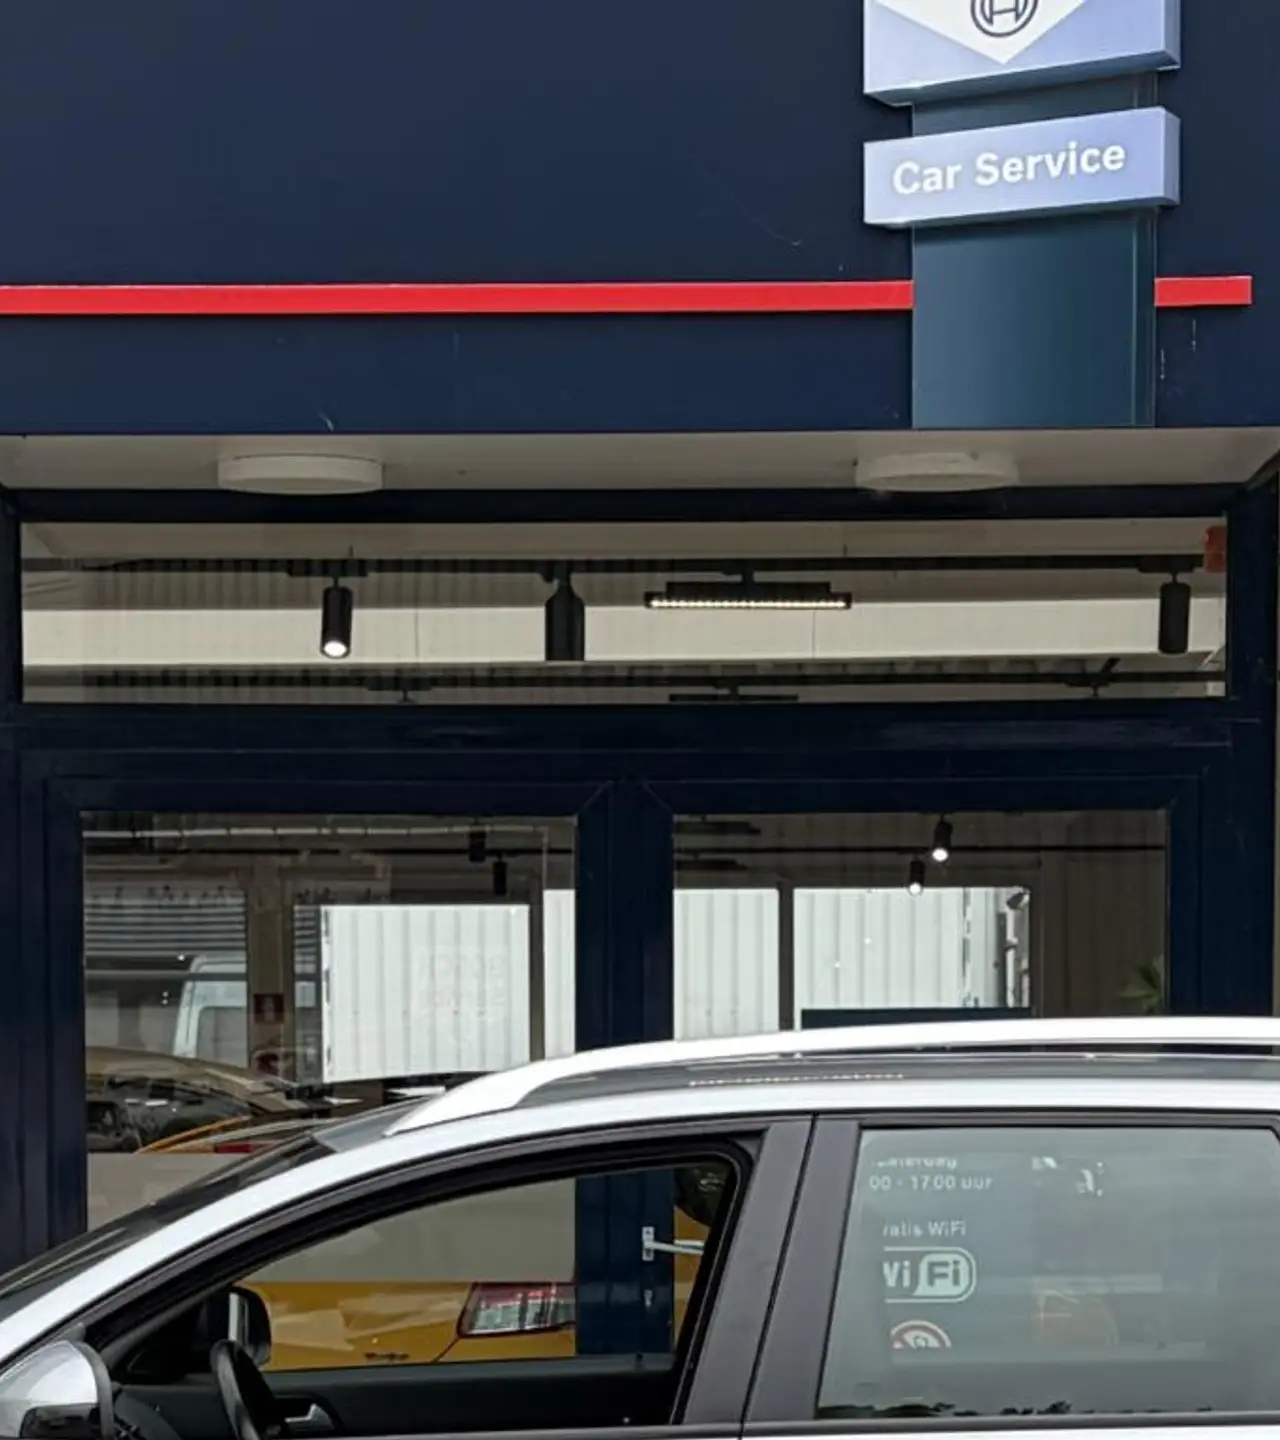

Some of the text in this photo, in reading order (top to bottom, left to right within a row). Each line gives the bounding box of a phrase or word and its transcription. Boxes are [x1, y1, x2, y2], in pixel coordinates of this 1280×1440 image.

[892, 142, 1125, 195] Car Service
[928, 1219, 966, 1237] WiFi
